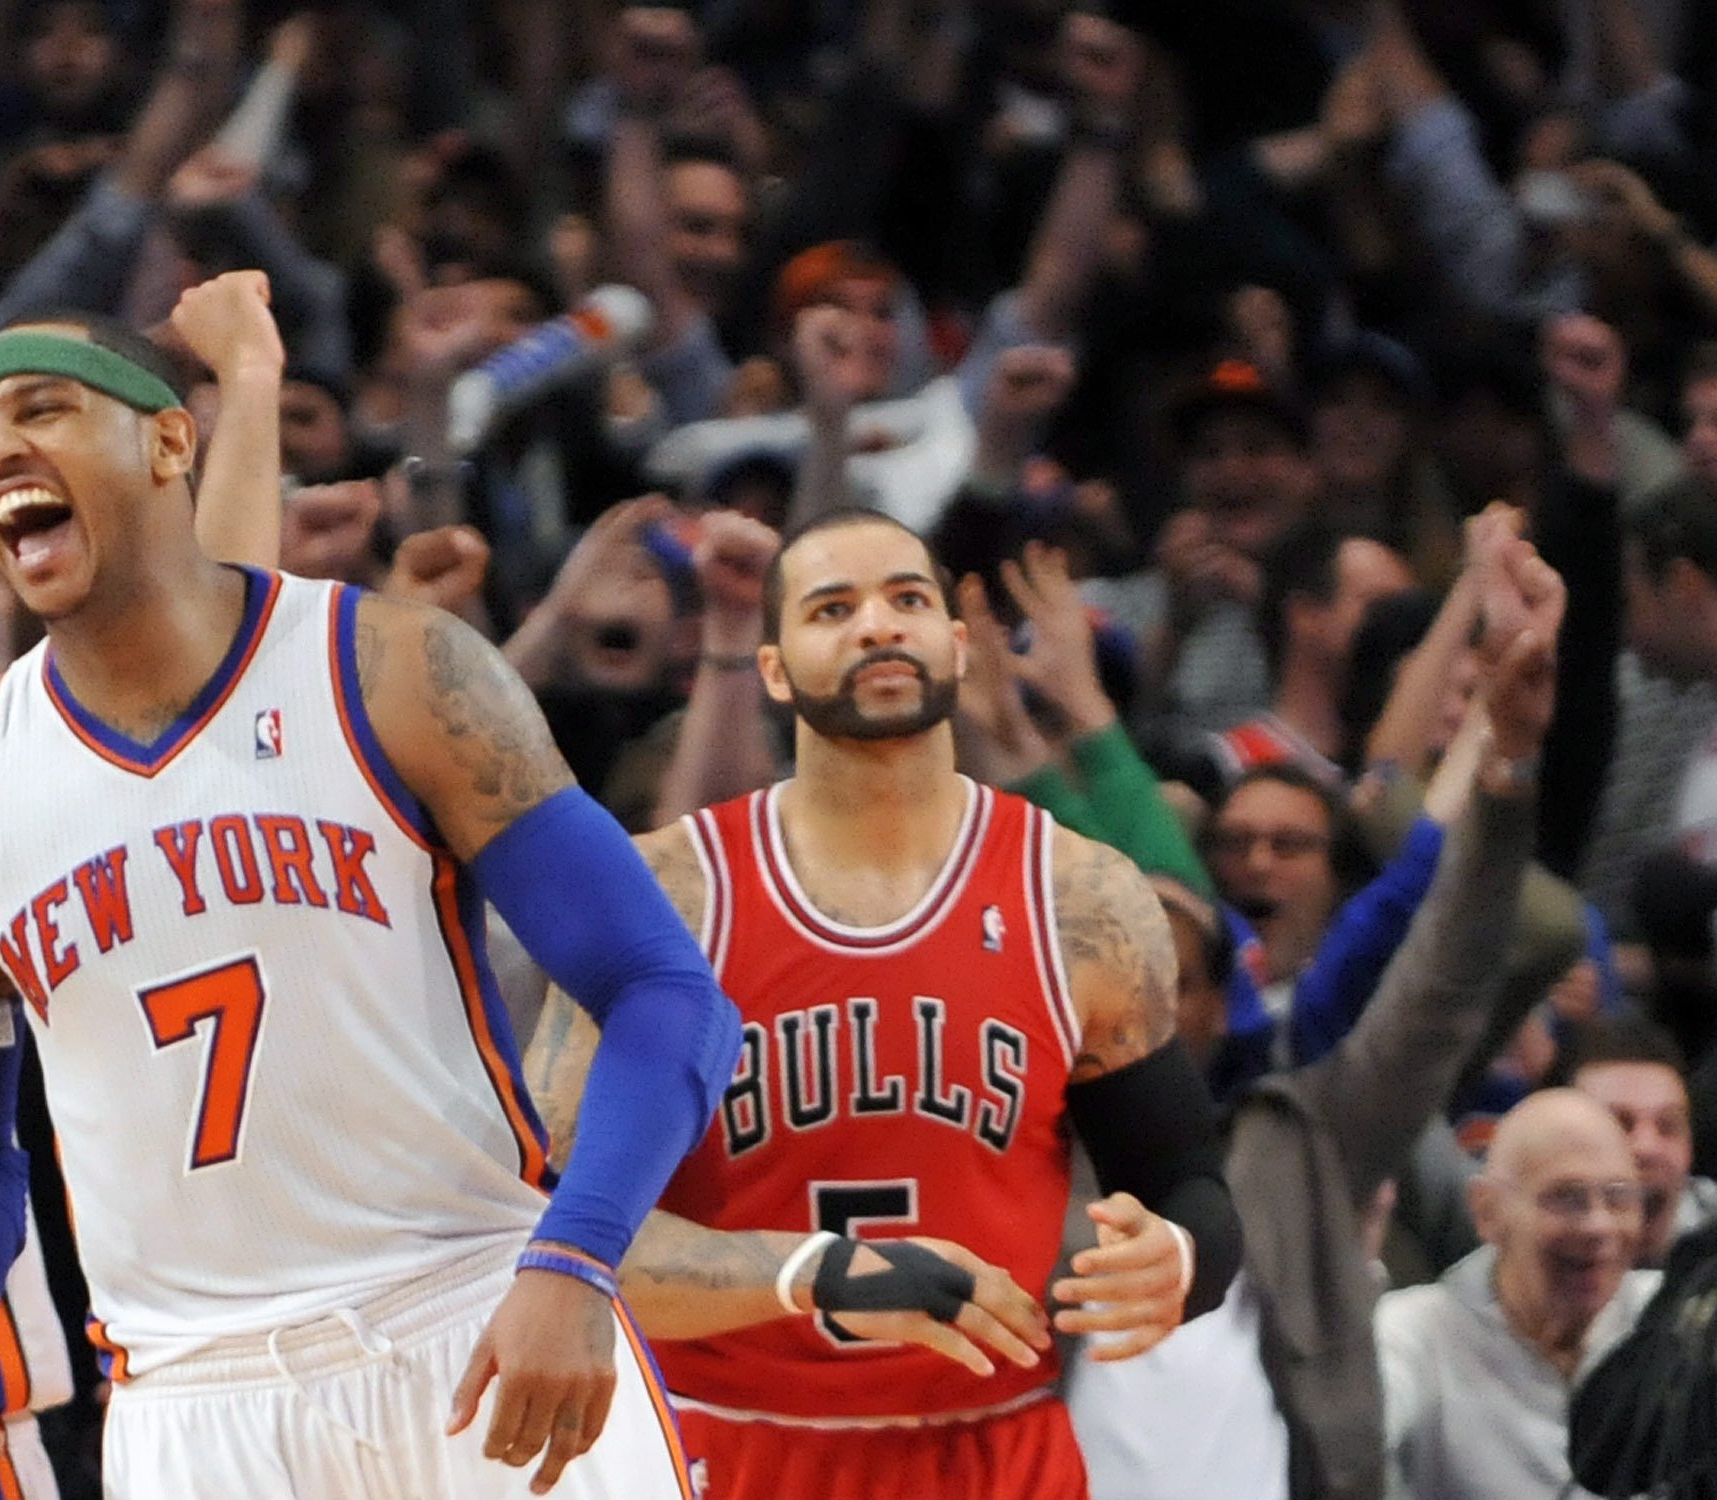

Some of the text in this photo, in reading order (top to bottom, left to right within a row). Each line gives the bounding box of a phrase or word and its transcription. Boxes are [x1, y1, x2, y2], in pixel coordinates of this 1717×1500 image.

[152, 811, 393, 930] YORK
[135, 948, 270, 1175] 7
[721, 995, 1029, 1161] BULLS
